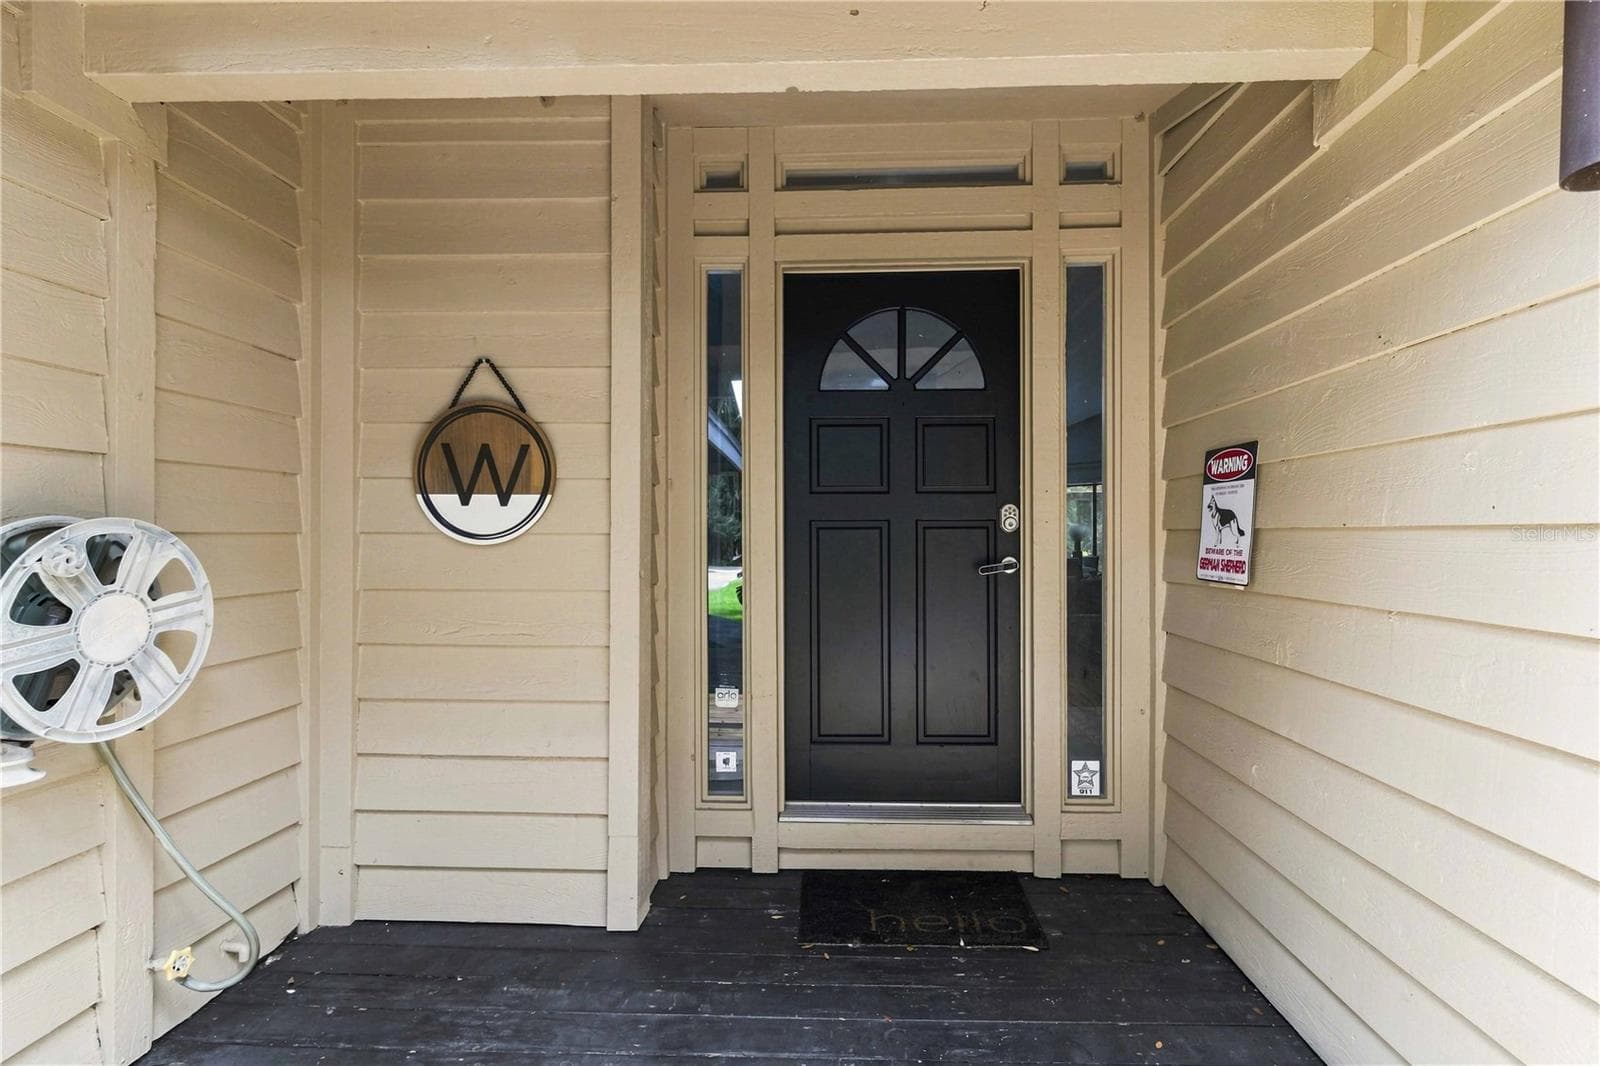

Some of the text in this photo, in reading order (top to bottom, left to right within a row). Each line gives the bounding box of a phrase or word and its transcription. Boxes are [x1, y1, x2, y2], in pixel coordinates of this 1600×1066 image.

[441, 443, 530, 507] W
[1211, 454, 1249, 475] WARNING
[1205, 547, 1225, 556] BEWARE
[1234, 549, 1243, 557] THE
[868, 908, 1027, 935] hello
